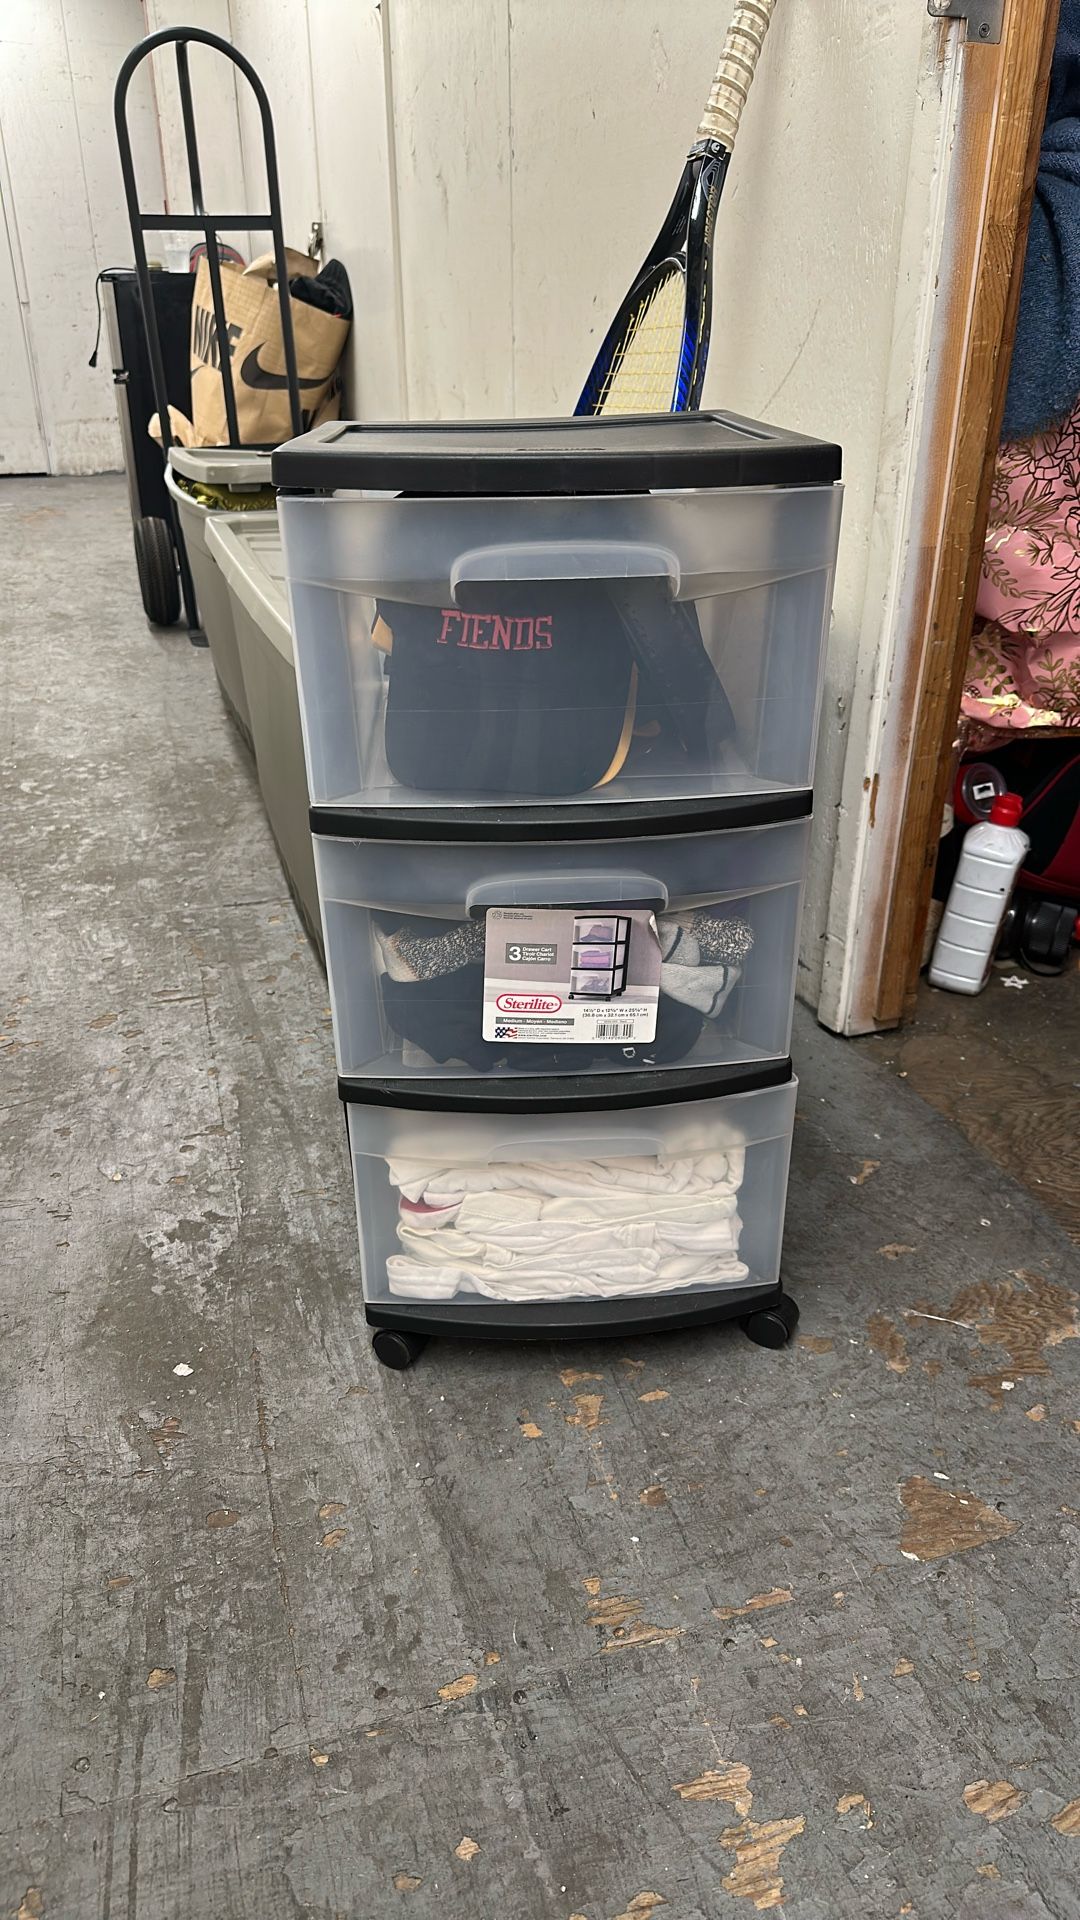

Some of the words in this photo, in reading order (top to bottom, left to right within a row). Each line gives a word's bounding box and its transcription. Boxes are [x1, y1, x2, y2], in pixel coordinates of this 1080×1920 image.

[437, 609, 553, 650] FIENDS
[508, 946, 522, 961] 3
[503, 997, 554, 1010] Sterilite
